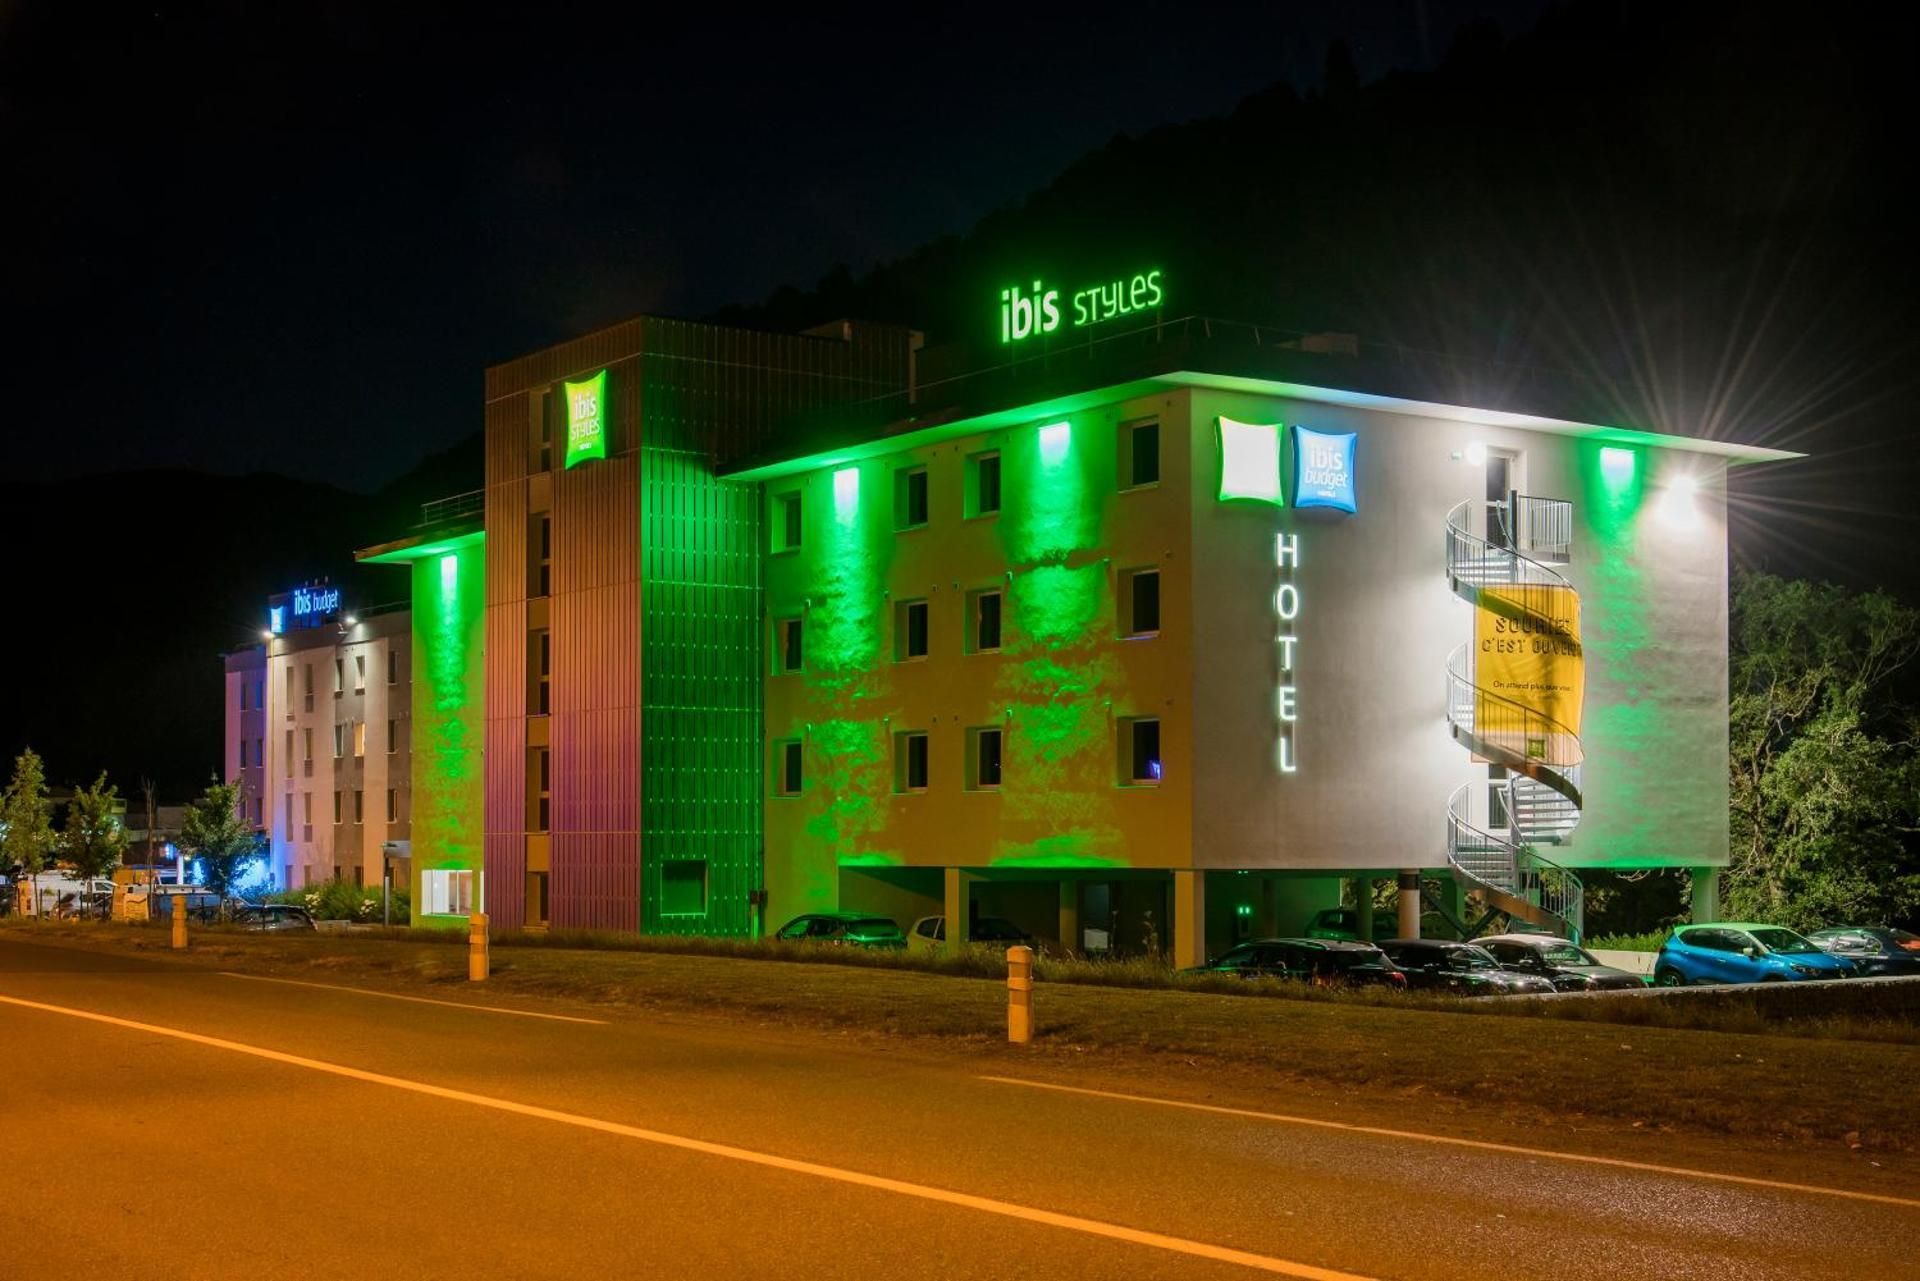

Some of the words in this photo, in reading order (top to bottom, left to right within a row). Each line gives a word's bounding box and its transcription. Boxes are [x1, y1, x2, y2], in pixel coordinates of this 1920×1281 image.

[1001, 280, 1060, 343] ibis
[1073, 270, 1162, 326] STYLES
[575, 392, 597, 419] ibis
[1310, 445, 1343, 470] ibis
[1304, 466, 1349, 490] budget
[294, 588, 311, 615] ibis
[312, 589, 339, 614] budget
[1276, 533, 1299, 773] HOTEL
[1493, 680, 1505, 689] On
